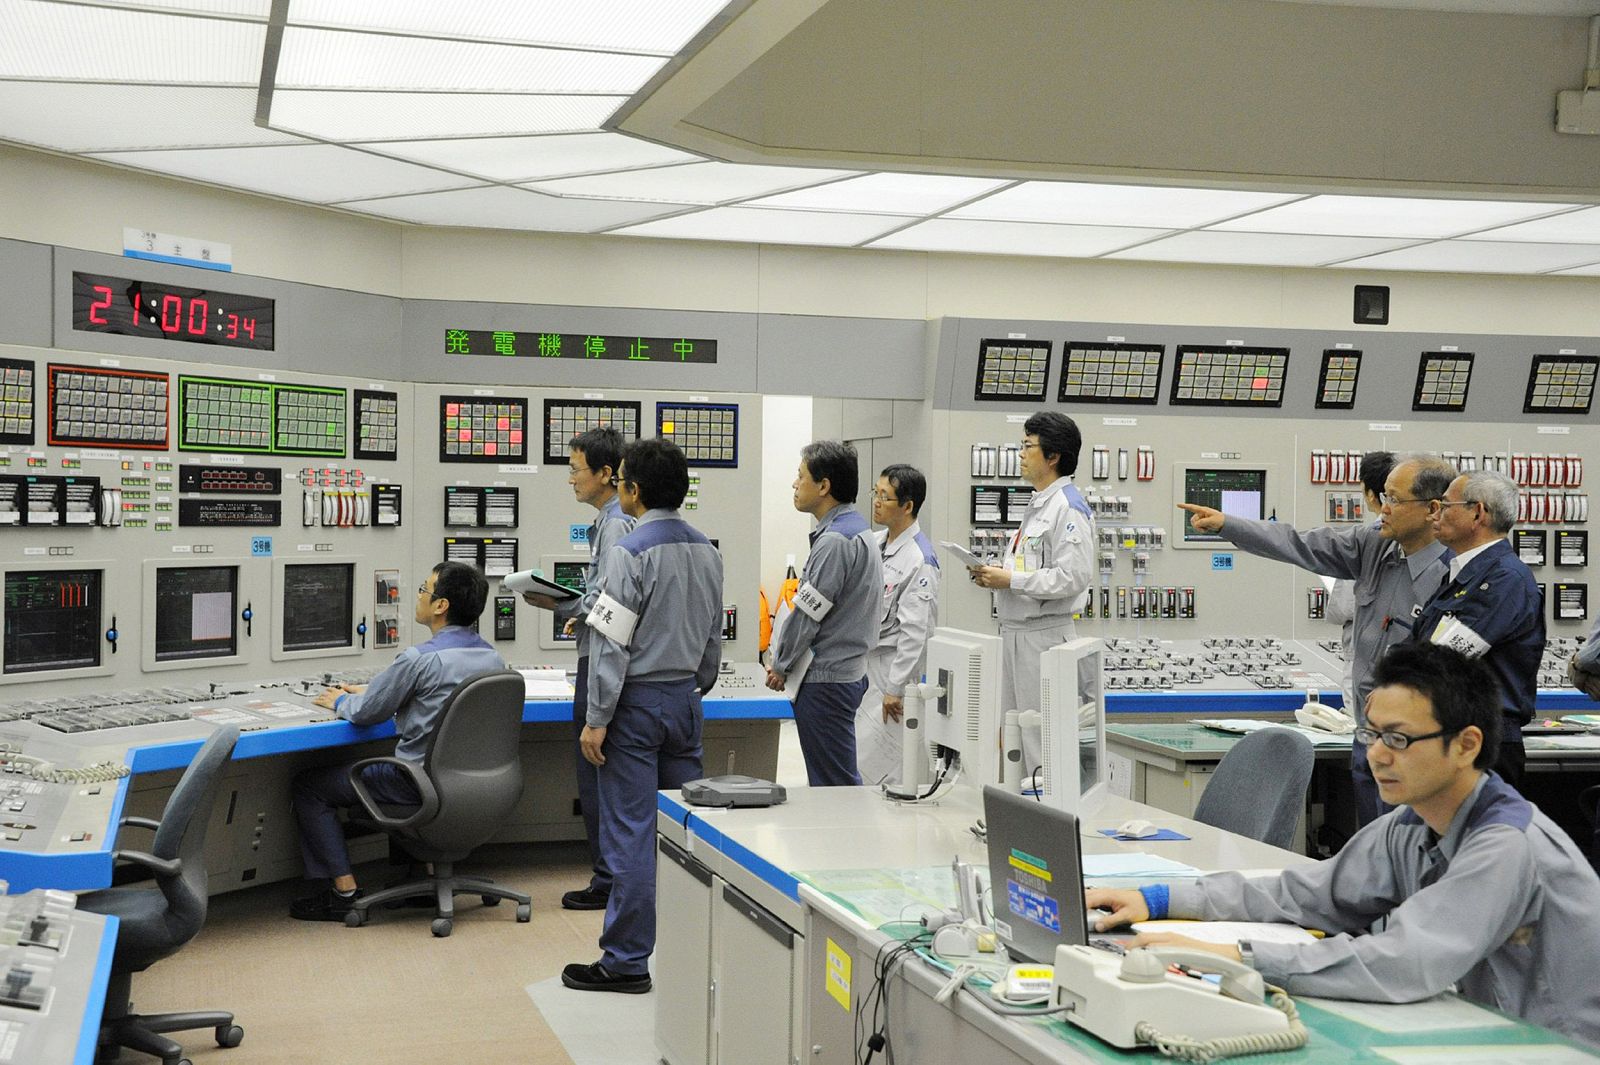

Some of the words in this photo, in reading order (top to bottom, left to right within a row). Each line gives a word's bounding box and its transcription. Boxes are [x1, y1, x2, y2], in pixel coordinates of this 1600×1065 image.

[446, 329, 693, 361] 発電機停止中
[253, 540, 271, 552] 3号機
[1213, 556, 1232, 567] 3号機
[1014, 868, 1048, 894] TOSHIBA
